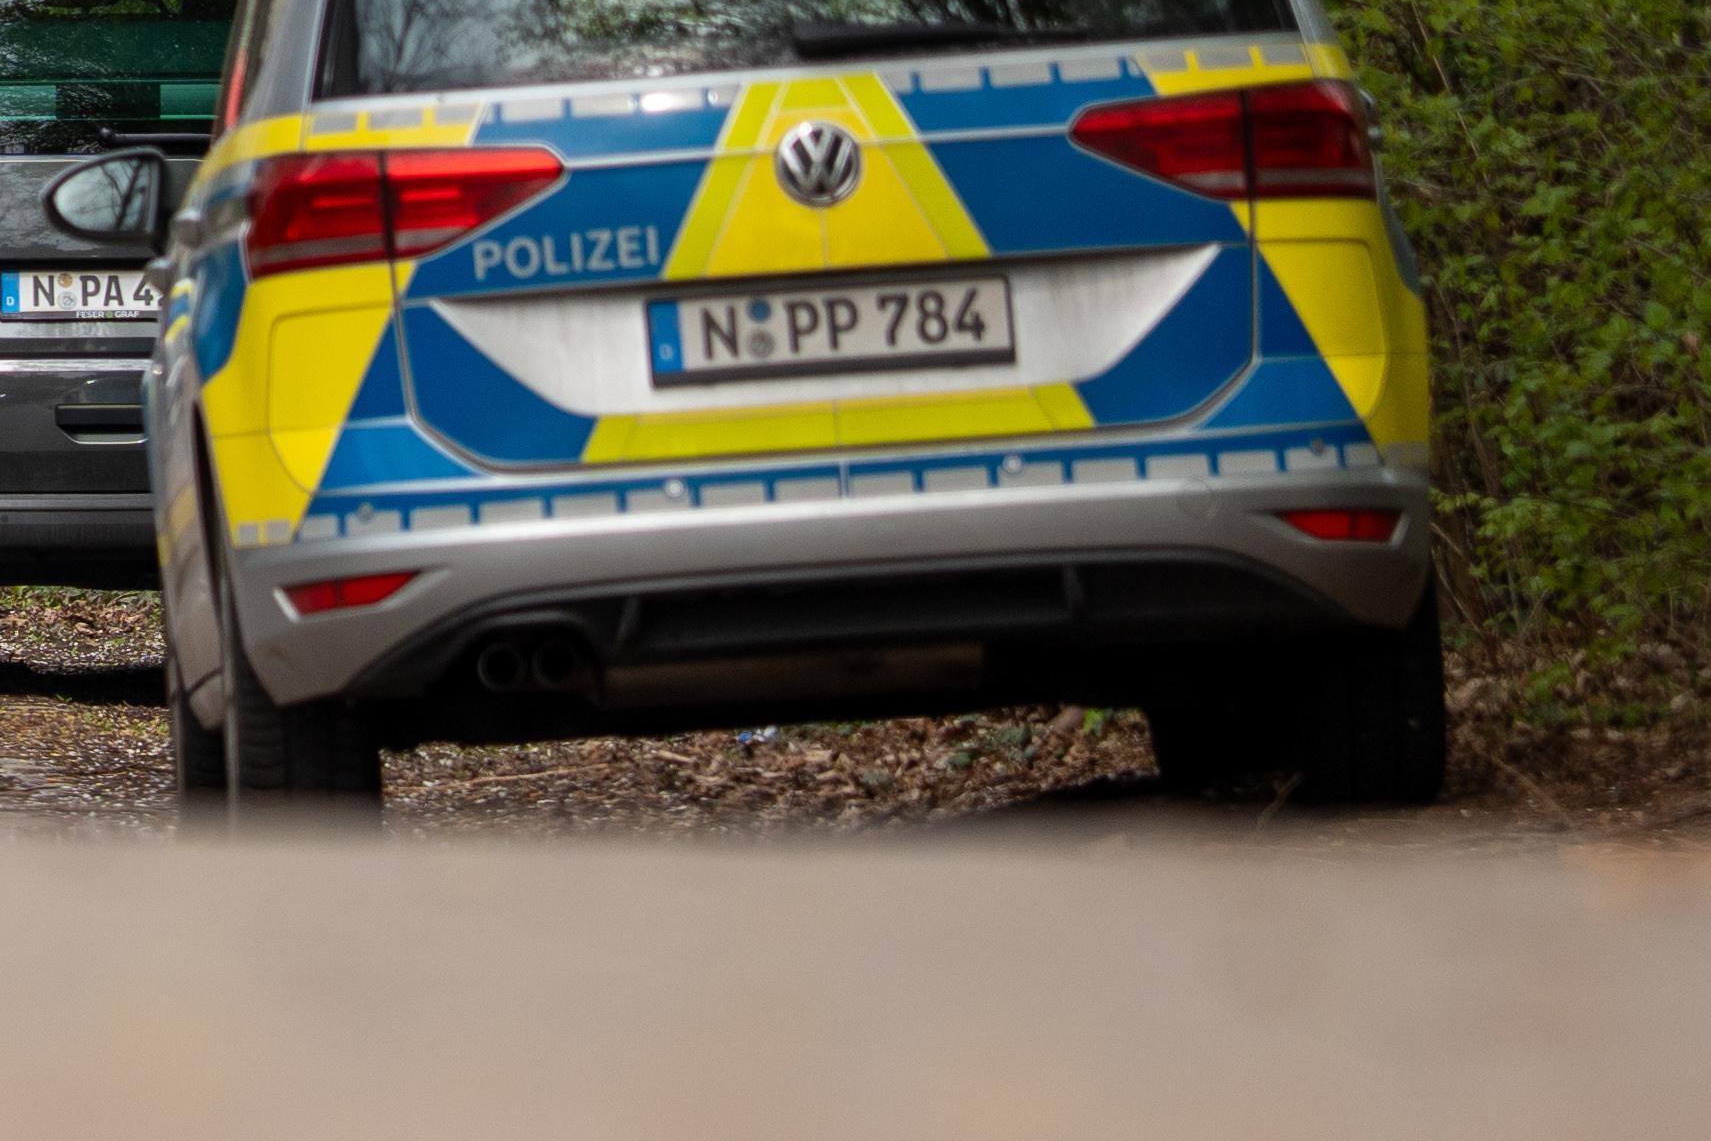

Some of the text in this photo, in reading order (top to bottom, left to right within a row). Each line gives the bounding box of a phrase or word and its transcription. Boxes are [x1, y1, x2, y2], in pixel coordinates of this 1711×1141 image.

[472, 224, 661, 282] POLIZEI
[6, 275, 162, 307] D N PA 4
[75, 310, 140, 319] FESER GRAF
[700, 305, 740, 360] N
[783, 297, 859, 354] PP
[876, 288, 986, 347] 784
